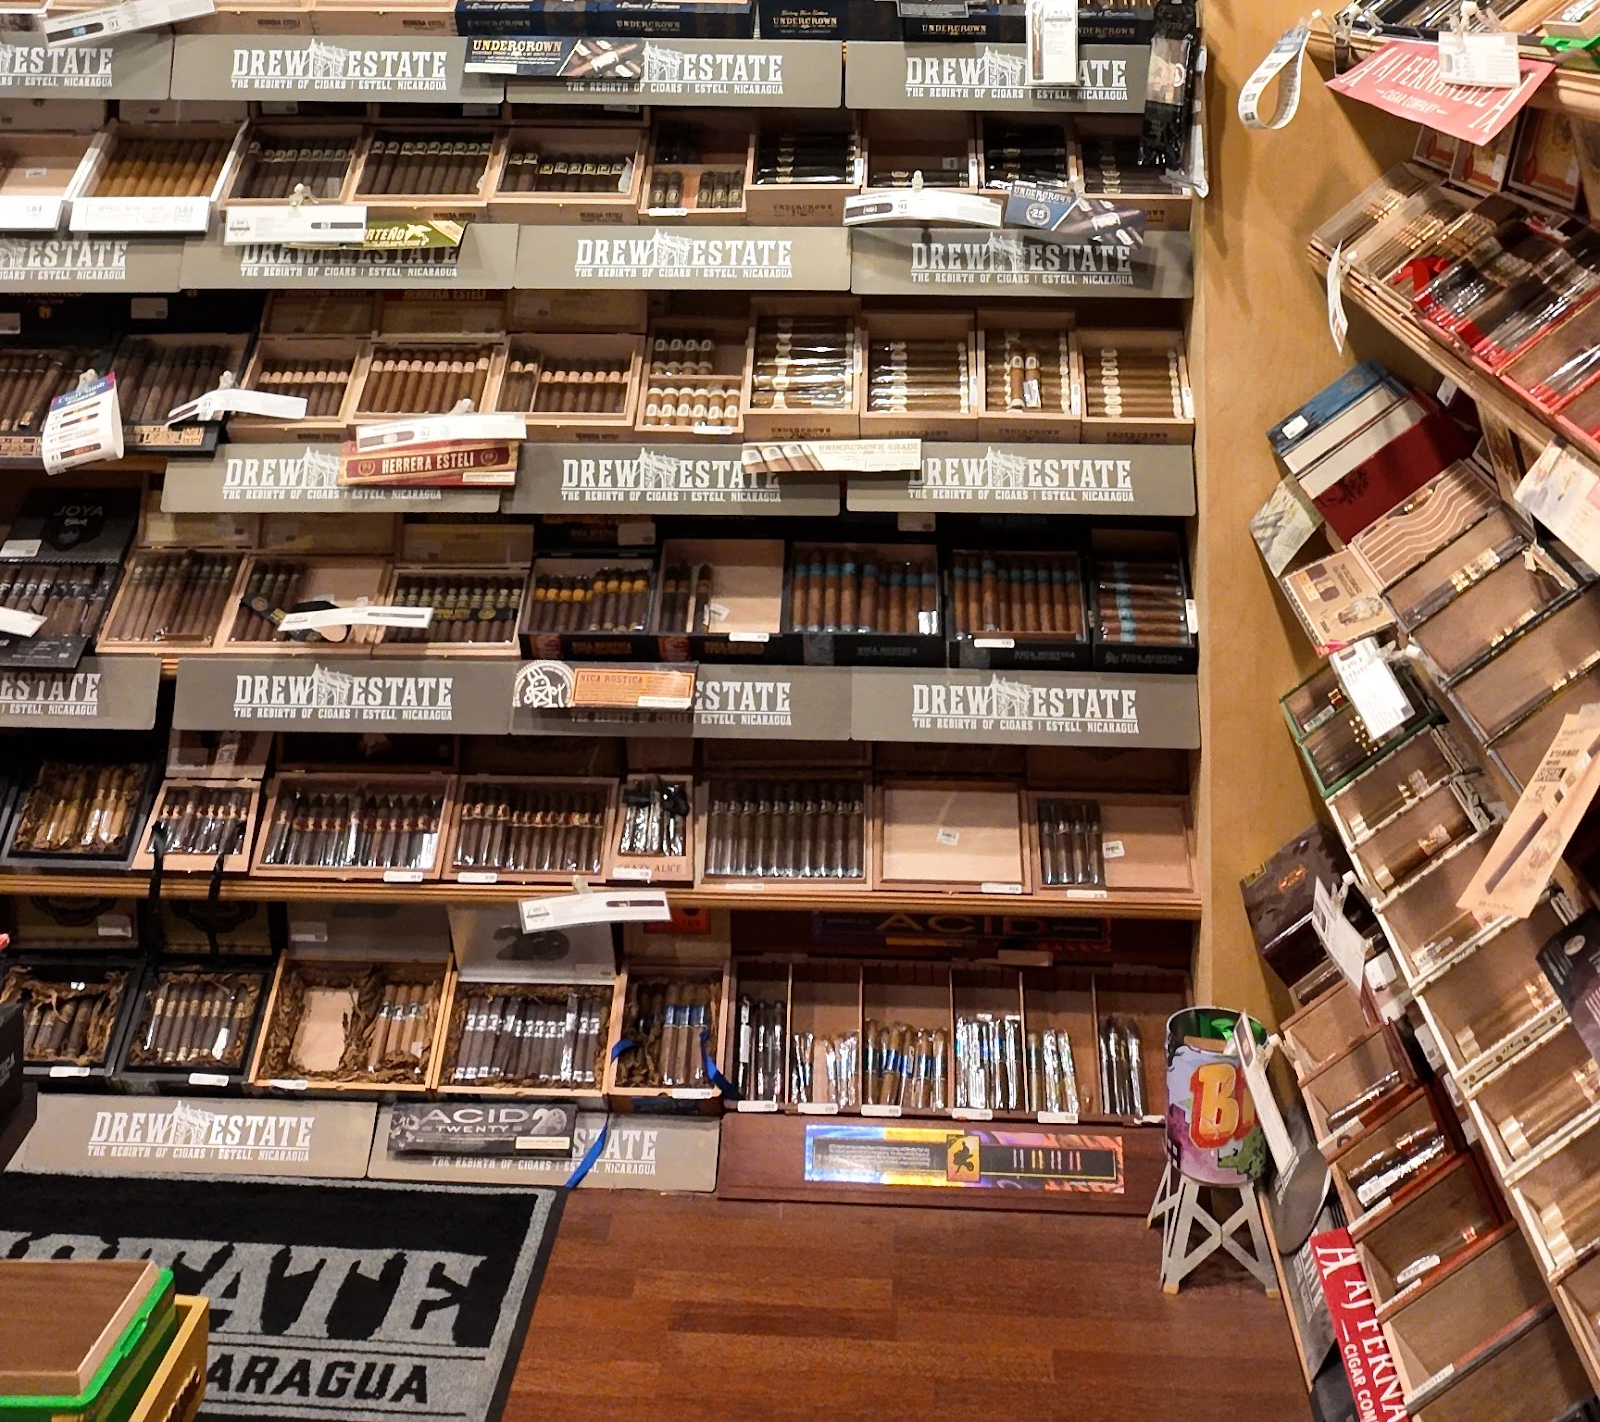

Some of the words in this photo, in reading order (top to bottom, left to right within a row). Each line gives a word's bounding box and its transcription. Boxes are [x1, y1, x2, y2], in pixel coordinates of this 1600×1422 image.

[472, 39, 563, 53] UNDERCROWN
[14, 47, 113, 75] ESTATE
[232, 49, 310, 77] DREW
[348, 51, 447, 78] ESTATE
[688, 54, 784, 82] ESTATE
[906, 56, 981, 85] DREW
[1013, 186, 1073, 204] UNDERCROWN
[27, 240, 128, 268] ESTATE
[577, 239, 649, 266] DREW
[692, 240, 793, 267] ESTATE
[911, 242, 983, 270] DREW
[1024, 244, 1132, 273] ESTATE
[226, 458, 305, 487] DREW
[381, 455, 432, 474] HERRERA
[437, 452, 474, 470] ESTELI
[562, 459, 639, 488] DREW
[1028, 459, 1132, 488] ESTATE
[53, 505, 104, 517] JOYA
[236, 674, 314, 705] DREW
[351, 677, 453, 706] ESTATE
[912, 684, 990, 716] DREW
[1032, 687, 1138, 719] ESTATE
[875, 913, 1048, 934] ACID
[92, 1111, 172, 1143] DREW
[208, 1114, 316, 1147] ESTATE
[422, 1108, 531, 1124] ACID
[436, 1125, 510, 1134] TWENTY
[1344, 1343, 1367, 1388] CIGAR
